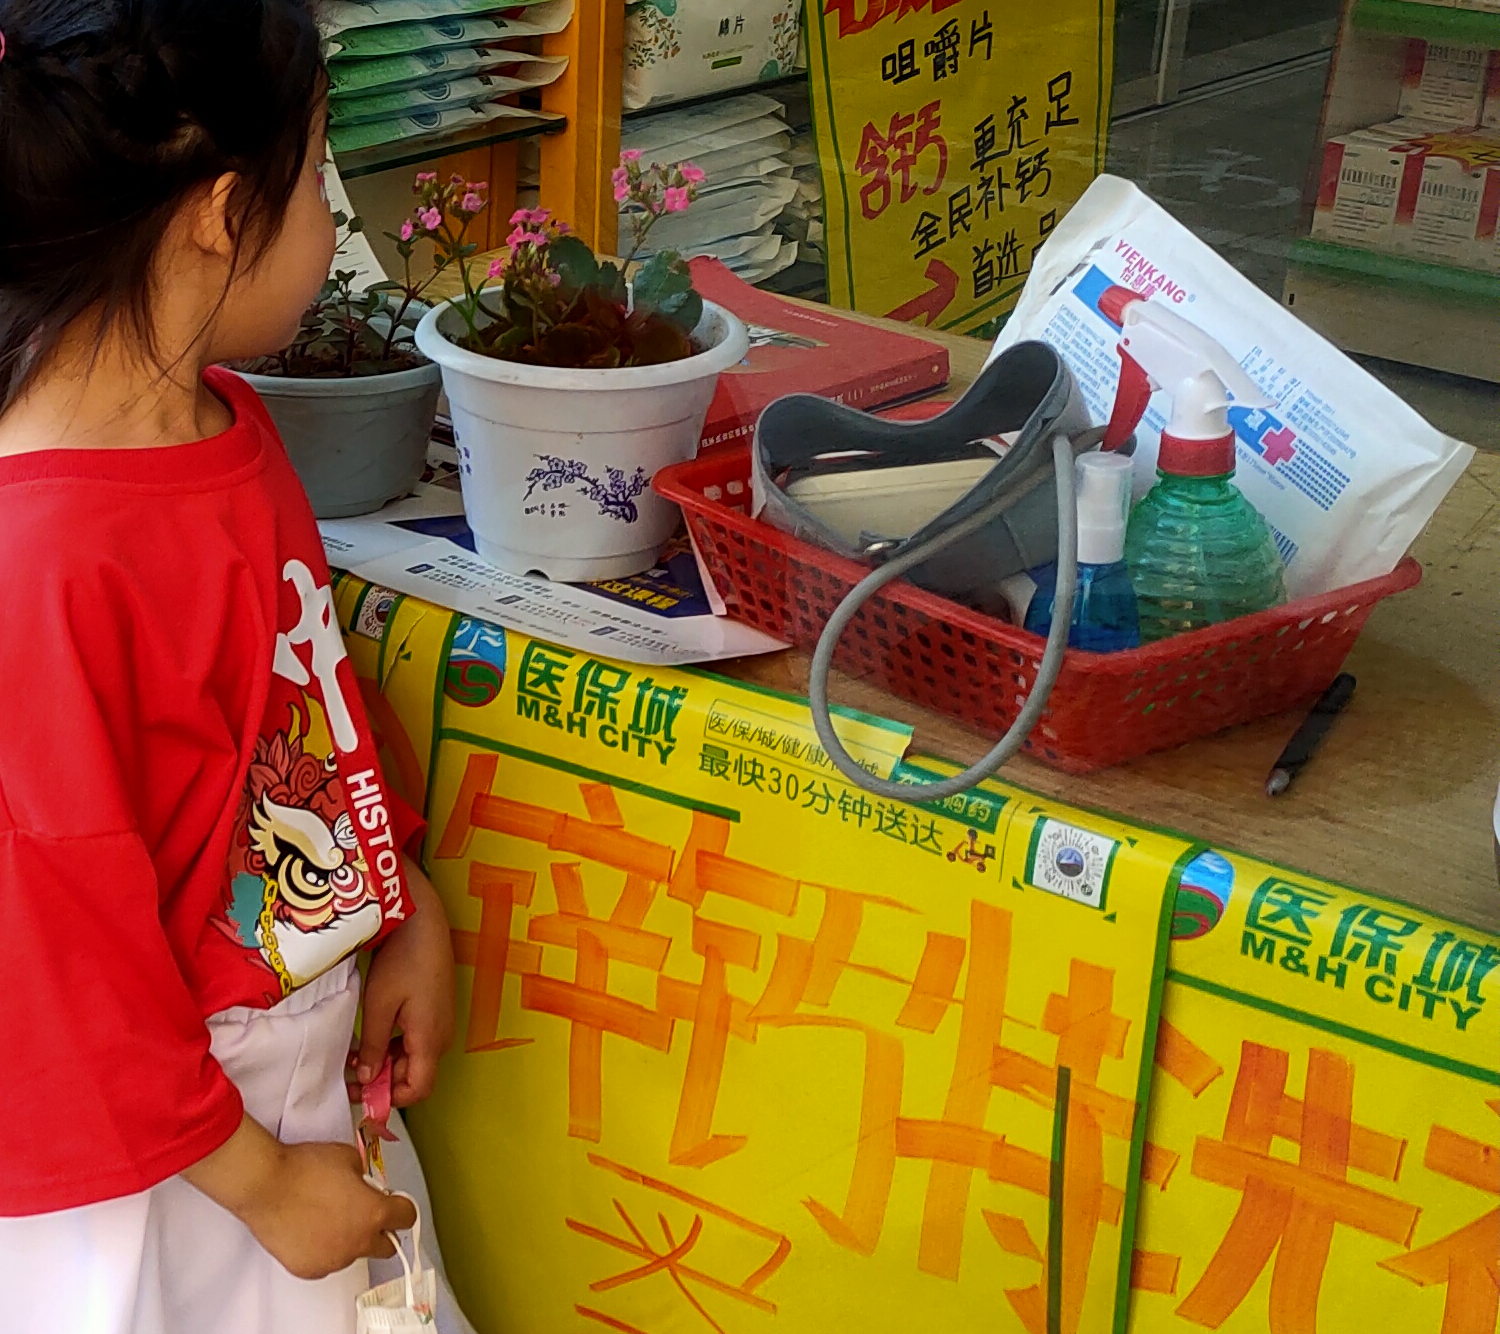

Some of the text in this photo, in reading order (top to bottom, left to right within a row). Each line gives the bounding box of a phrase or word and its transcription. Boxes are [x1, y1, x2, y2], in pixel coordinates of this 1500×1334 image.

[911, 147, 1054, 261] 全民补钙
[1113, 238, 1188, 305] YIENKANG
[516, 640, 687, 746] 医保城
[516, 693, 677, 767] M&H CITY
[345, 767, 407, 926] HISTORY
[698, 742, 944, 856] 最快30分钟送达
[1241, 929, 1484, 1033] M&H CITY
[1244, 875, 1500, 1008] 医保城
